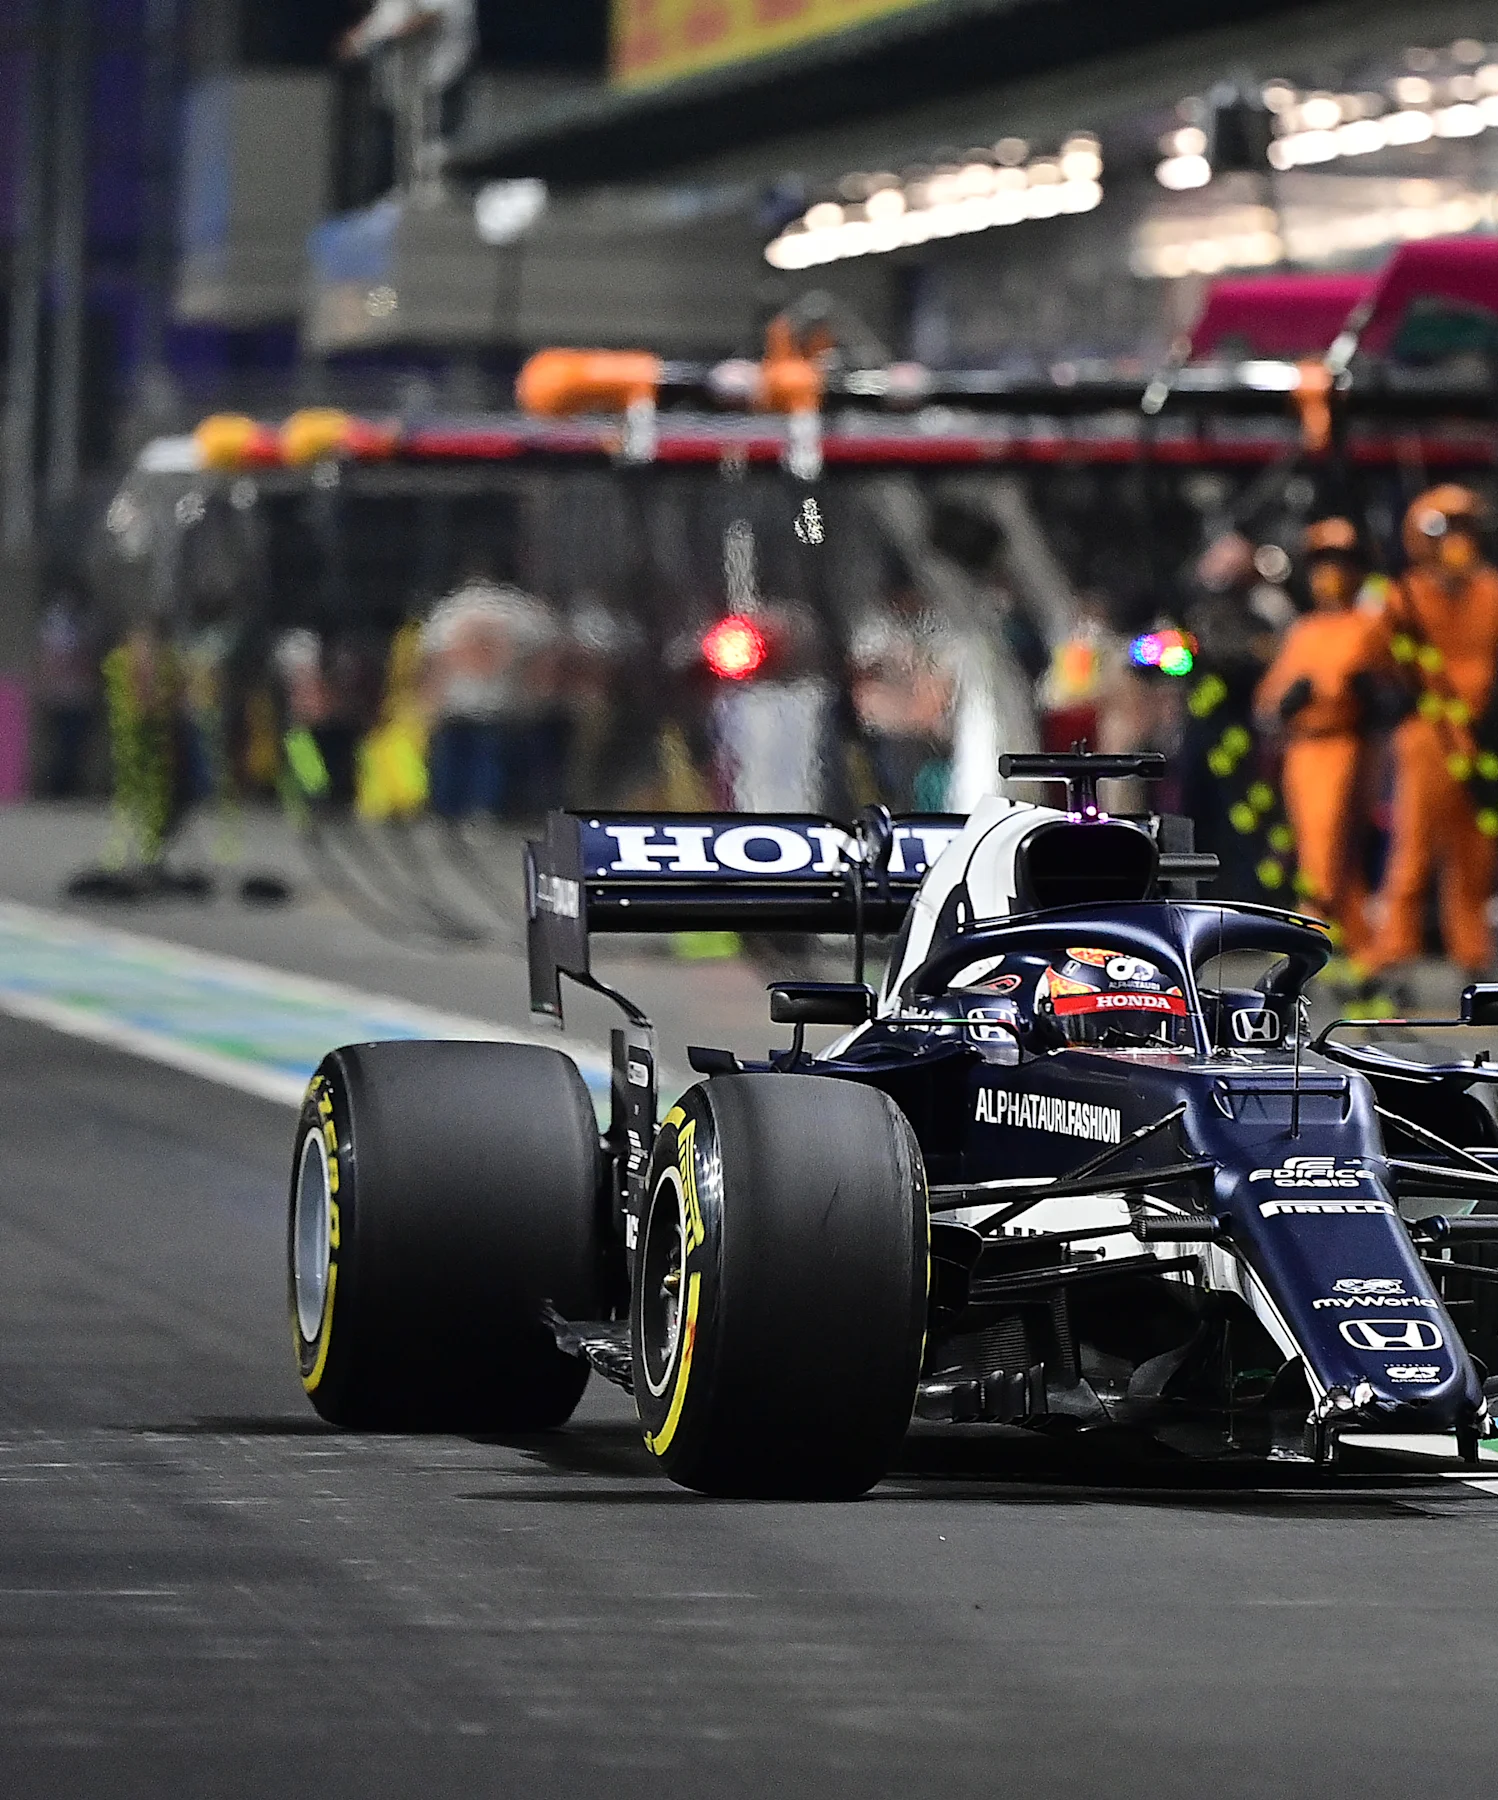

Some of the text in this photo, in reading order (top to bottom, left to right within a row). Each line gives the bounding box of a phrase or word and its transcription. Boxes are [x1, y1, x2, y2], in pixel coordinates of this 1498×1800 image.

[1096, 995, 1171, 1009] HONDA
[975, 1087, 1121, 1144] ALPHATAURI.FASHION
[1249, 1169, 1375, 1182] EDIFICE
[1274, 1179, 1360, 1188] CASIO
[1259, 1200, 1396, 1218] PIRELLI
[1312, 1296, 1439, 1309] myWorld
